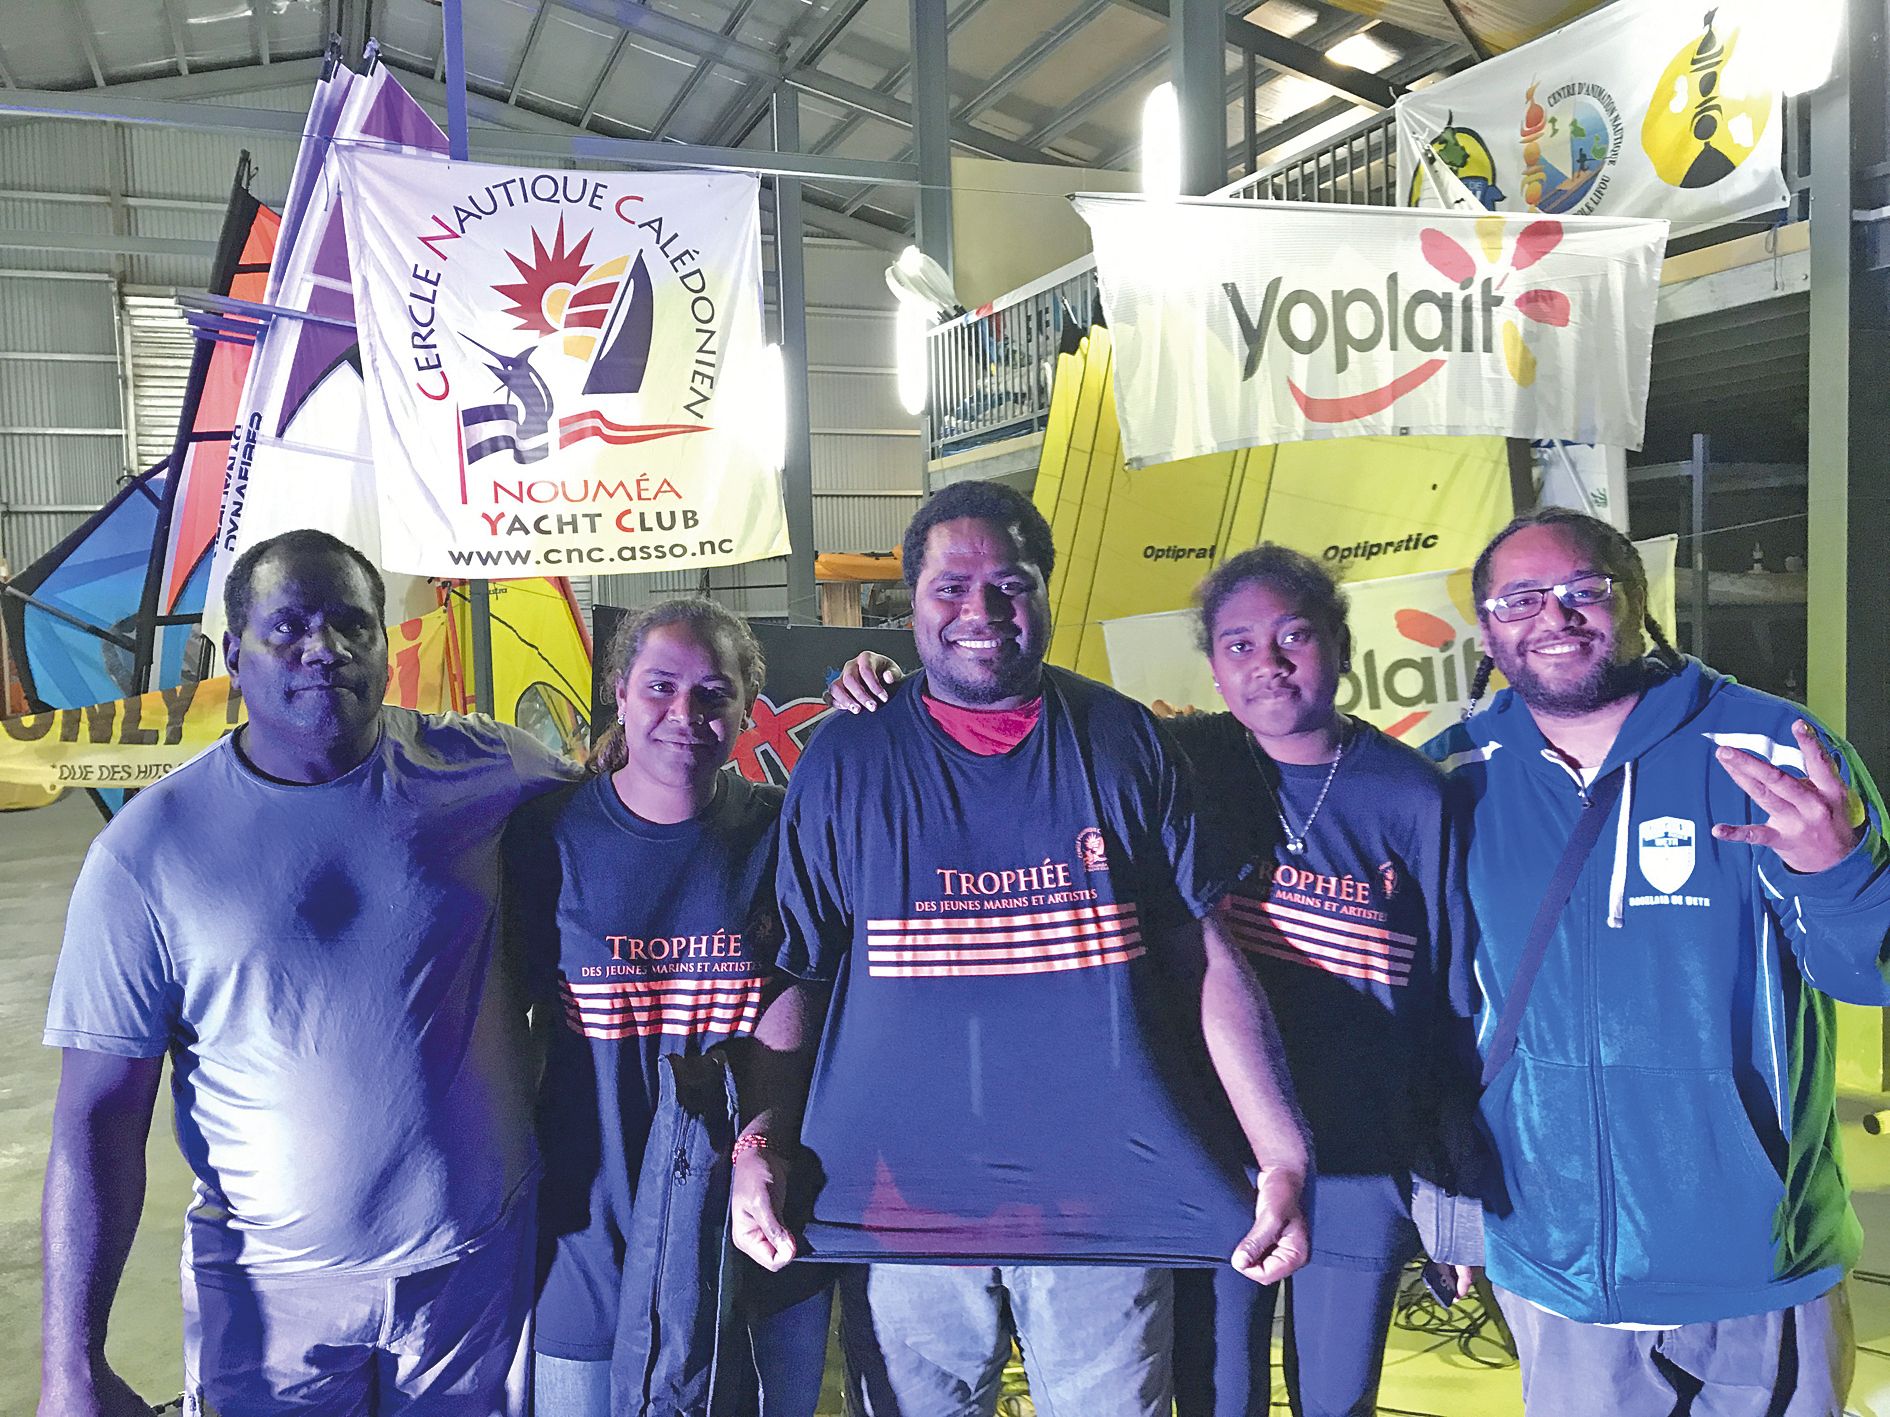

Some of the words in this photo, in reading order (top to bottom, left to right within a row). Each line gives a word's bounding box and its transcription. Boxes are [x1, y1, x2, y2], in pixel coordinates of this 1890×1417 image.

[1547, 83, 1576, 107] CENTRE
[1577, 82, 1618, 117] D'ANIMATION
[1607, 113, 1624, 166] NAUTIQUE
[1590, 174, 1611, 206] LIFOU
[417, 174, 609, 261] NAUTIQUE
[615, 195, 716, 419] CALÉDONIEN
[411, 263, 450, 401] CERCLE
[493, 472, 682, 504] NOUMÉA
[481, 512, 602, 536] YACHT
[615, 508, 699, 533] CLUB
[448, 537, 734, 566] www.cnc.asso.nc
[1143, 544, 1217, 561] Optiprat
[1323, 533, 1440, 563] Optipratic
[98, 764, 132, 781] DES
[936, 857, 1072, 896] TROPHÉE
[1257, 861, 1370, 905] ROPHÉE
[915, 901, 937, 912] DES
[940, 900, 981, 913] JEUNES
[984, 896, 1028, 910] MARINS
[1031, 894, 1045, 906] ET
[1047, 888, 1098, 905] ARTISTES
[1275, 889, 1322, 908] MARINS
[1324, 901, 1339, 913] ET
[605, 927, 742, 961] TROPHÉE
[581, 966, 602, 977] DES
[605, 964, 648, 978] JEUNES
[651, 962, 695, 975] MARINS
[697, 962, 710, 973] ET
